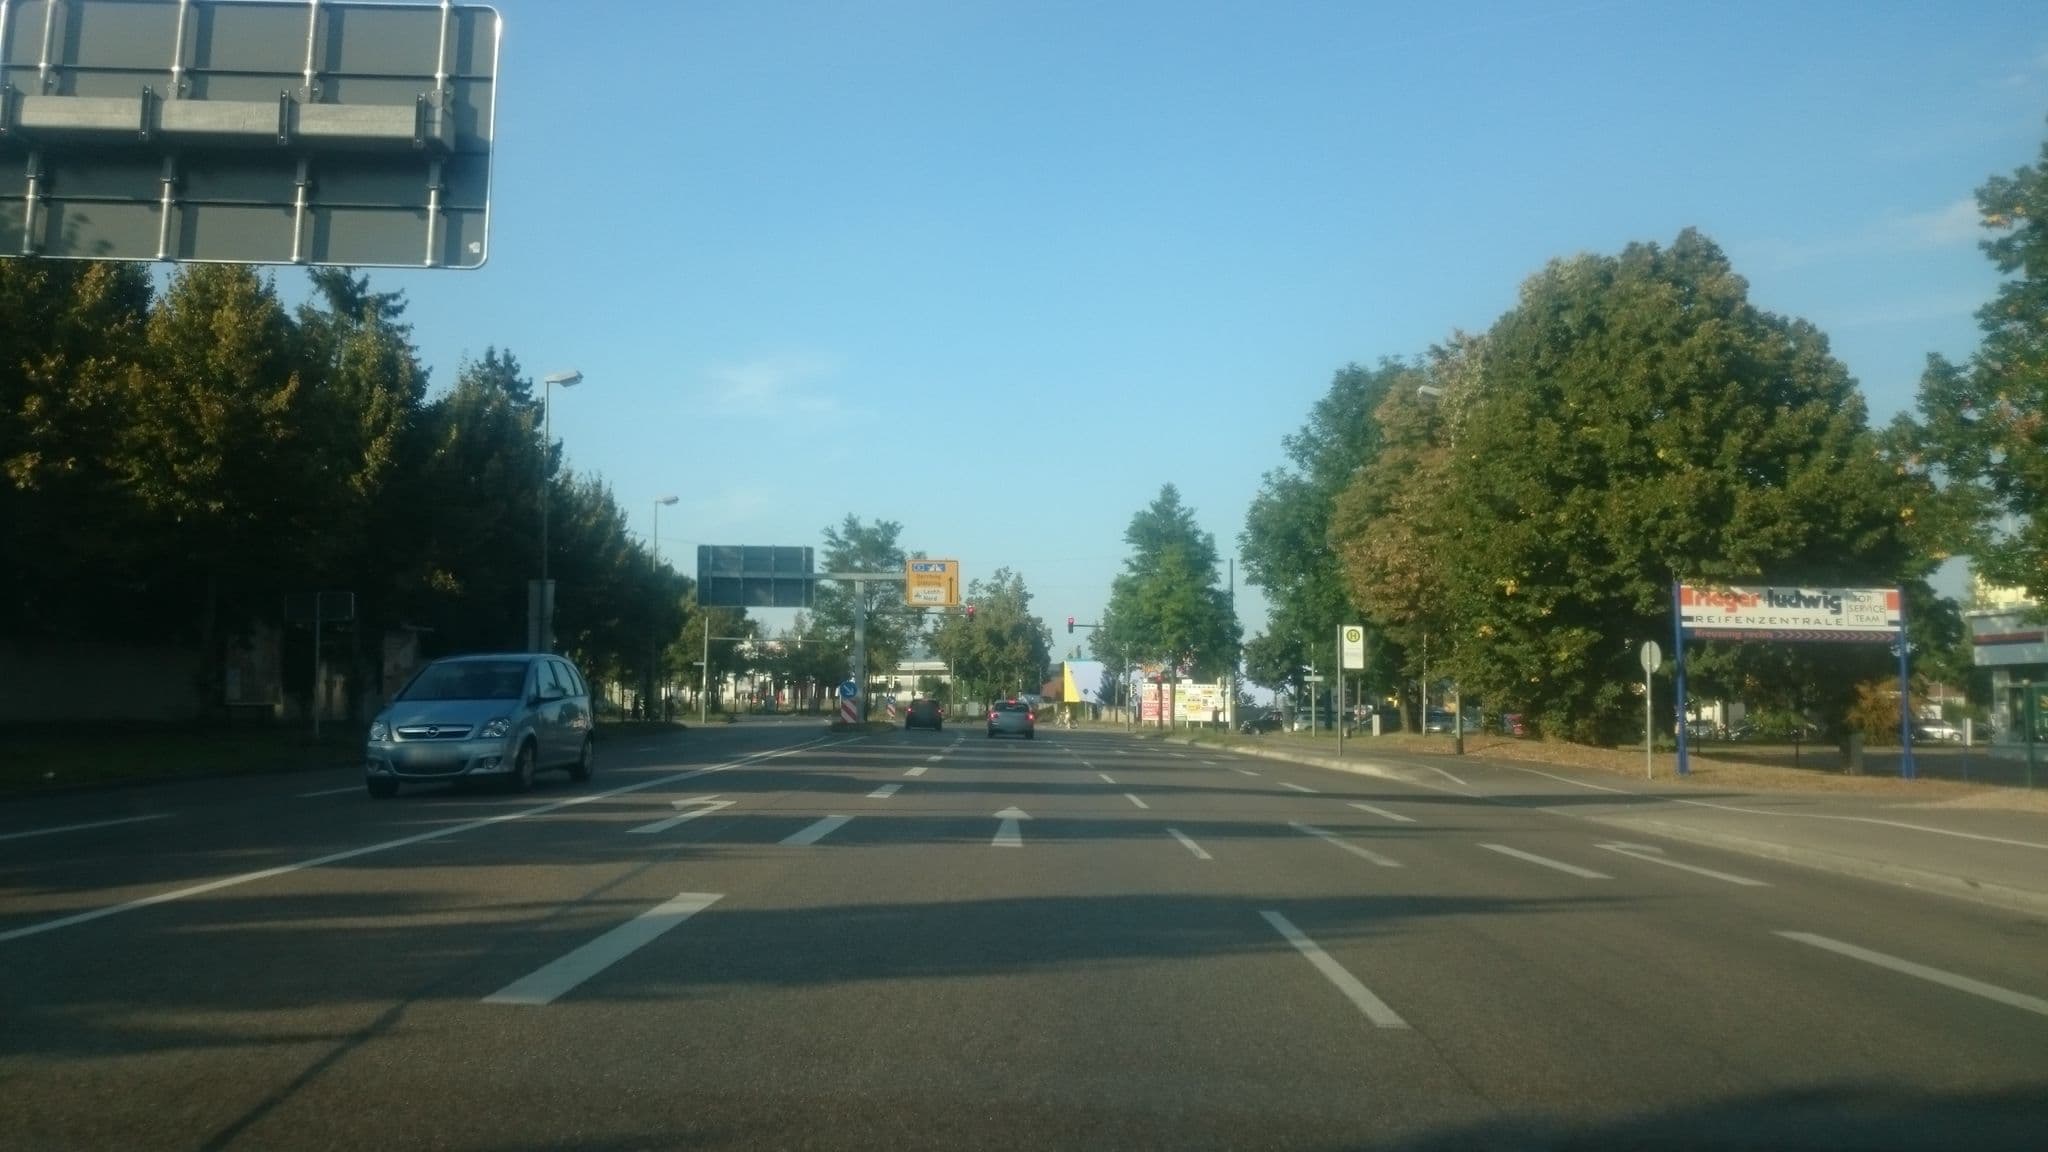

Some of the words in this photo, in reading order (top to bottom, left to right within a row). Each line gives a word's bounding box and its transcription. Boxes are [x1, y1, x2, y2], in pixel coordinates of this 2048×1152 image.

[1768, 588, 1842, 615] ludwig
[1855, 595, 1873, 603] TOP
[1849, 604, 1885, 613] SERVICE
[1695, 615, 1843, 626] REIFENZENTRALE
[1855, 615, 1880, 623] TEAM
